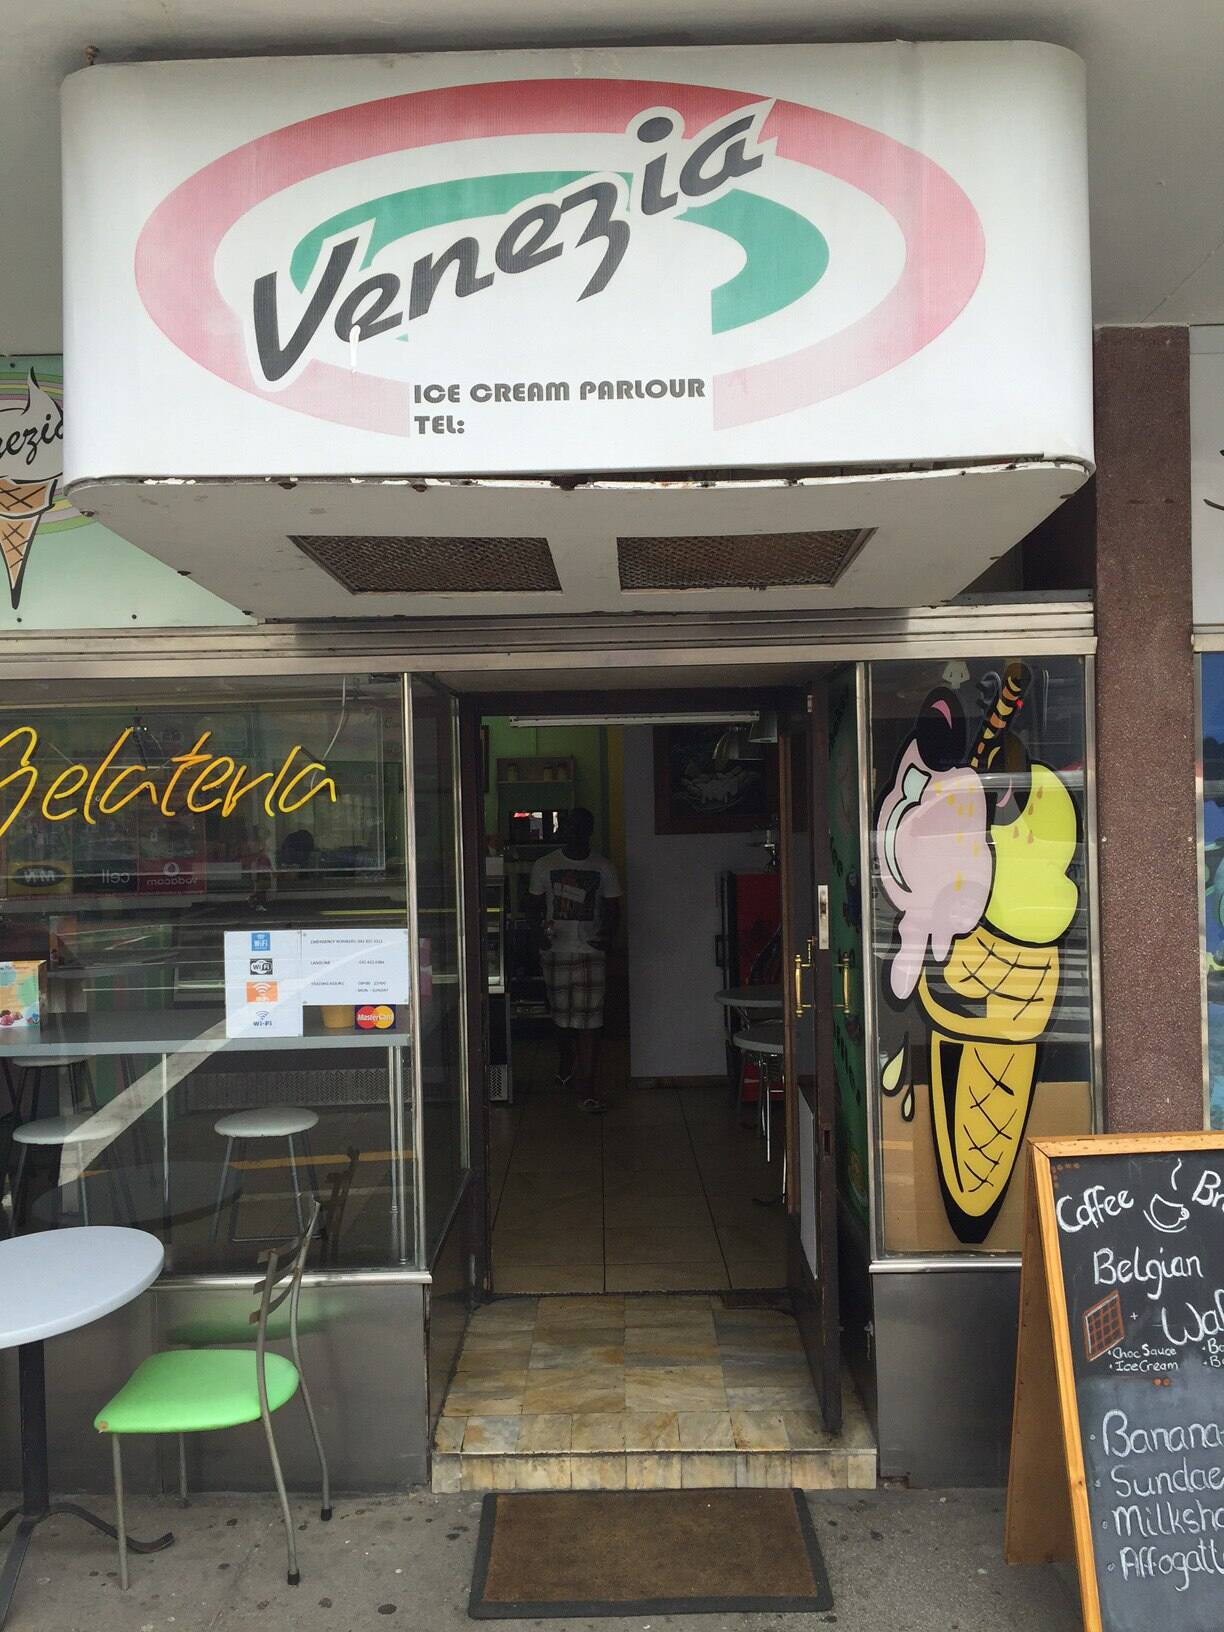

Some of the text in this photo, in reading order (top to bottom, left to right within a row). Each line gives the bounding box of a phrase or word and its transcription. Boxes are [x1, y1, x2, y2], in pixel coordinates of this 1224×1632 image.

[253, 114, 764, 382] Venezia
[414, 379, 705, 403] ICE CREAM PARLOUR
[414, 415, 465, 434] TEL:
[1056, 1170, 1224, 1233] Coffee Br
[1093, 1246, 1204, 1300] Belgian
[1112, 1343, 1177, 1359] Choc Sauce
[1119, 1538, 1224, 1592] Affogatt
